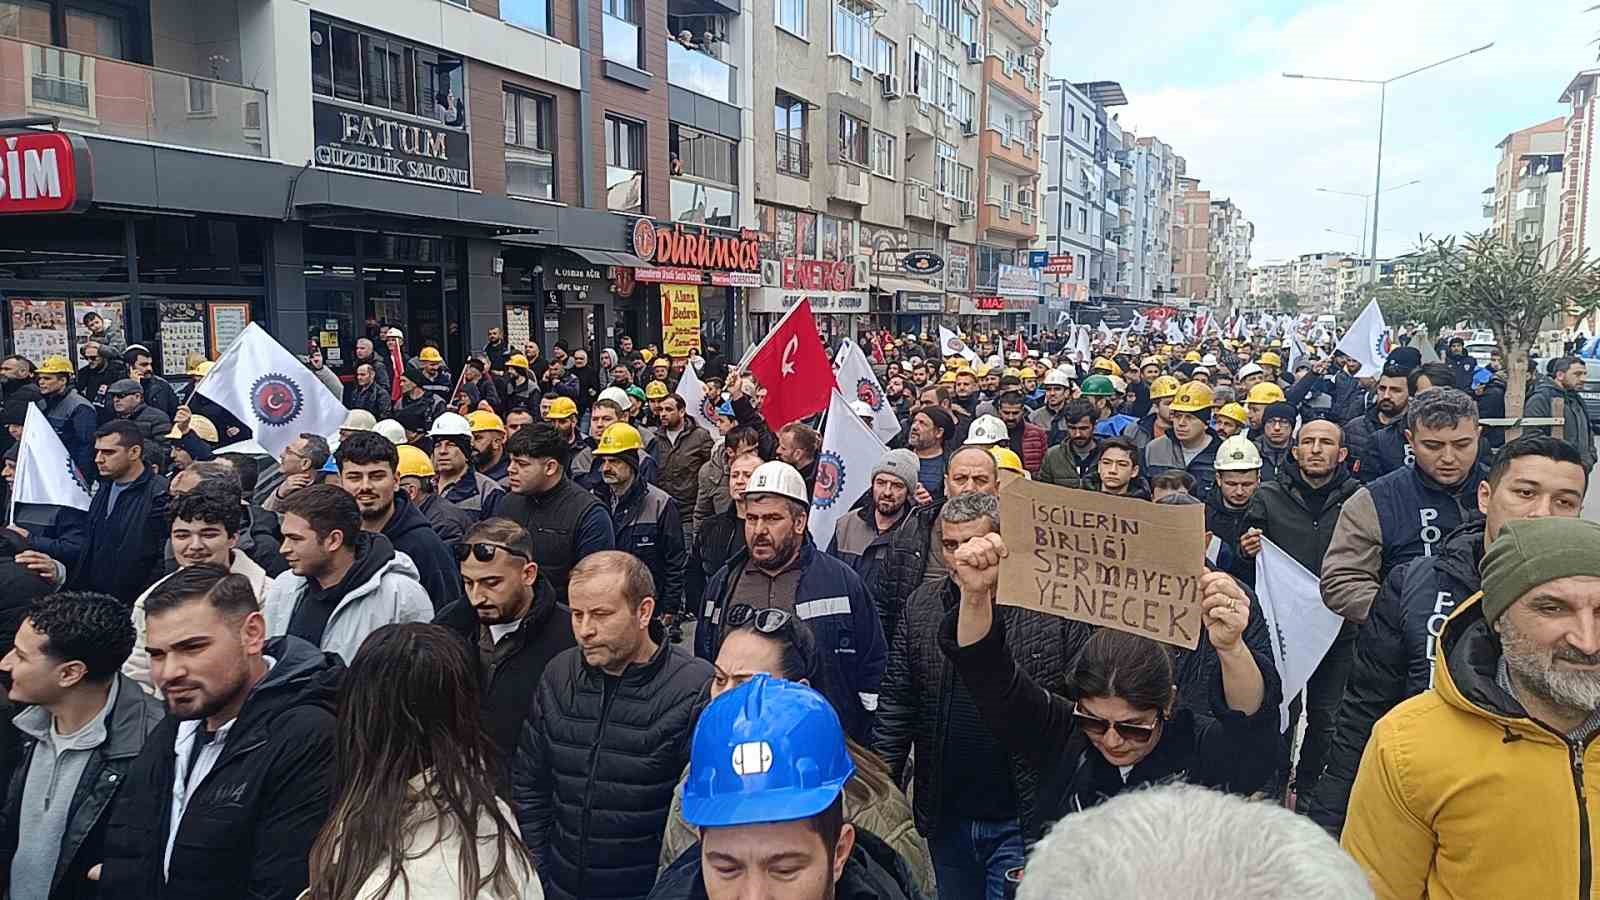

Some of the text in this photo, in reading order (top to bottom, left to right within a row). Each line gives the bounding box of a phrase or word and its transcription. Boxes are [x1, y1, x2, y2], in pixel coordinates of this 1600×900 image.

[340, 111, 448, 160] FATUM
[316, 142, 469, 186] GÜZELLİK SALONU
[1034, 526, 1127, 561] BİRLİĞİ
[1034, 549, 1199, 603] SERMAYEYİ
[1035, 577, 1192, 641] YENECEK
